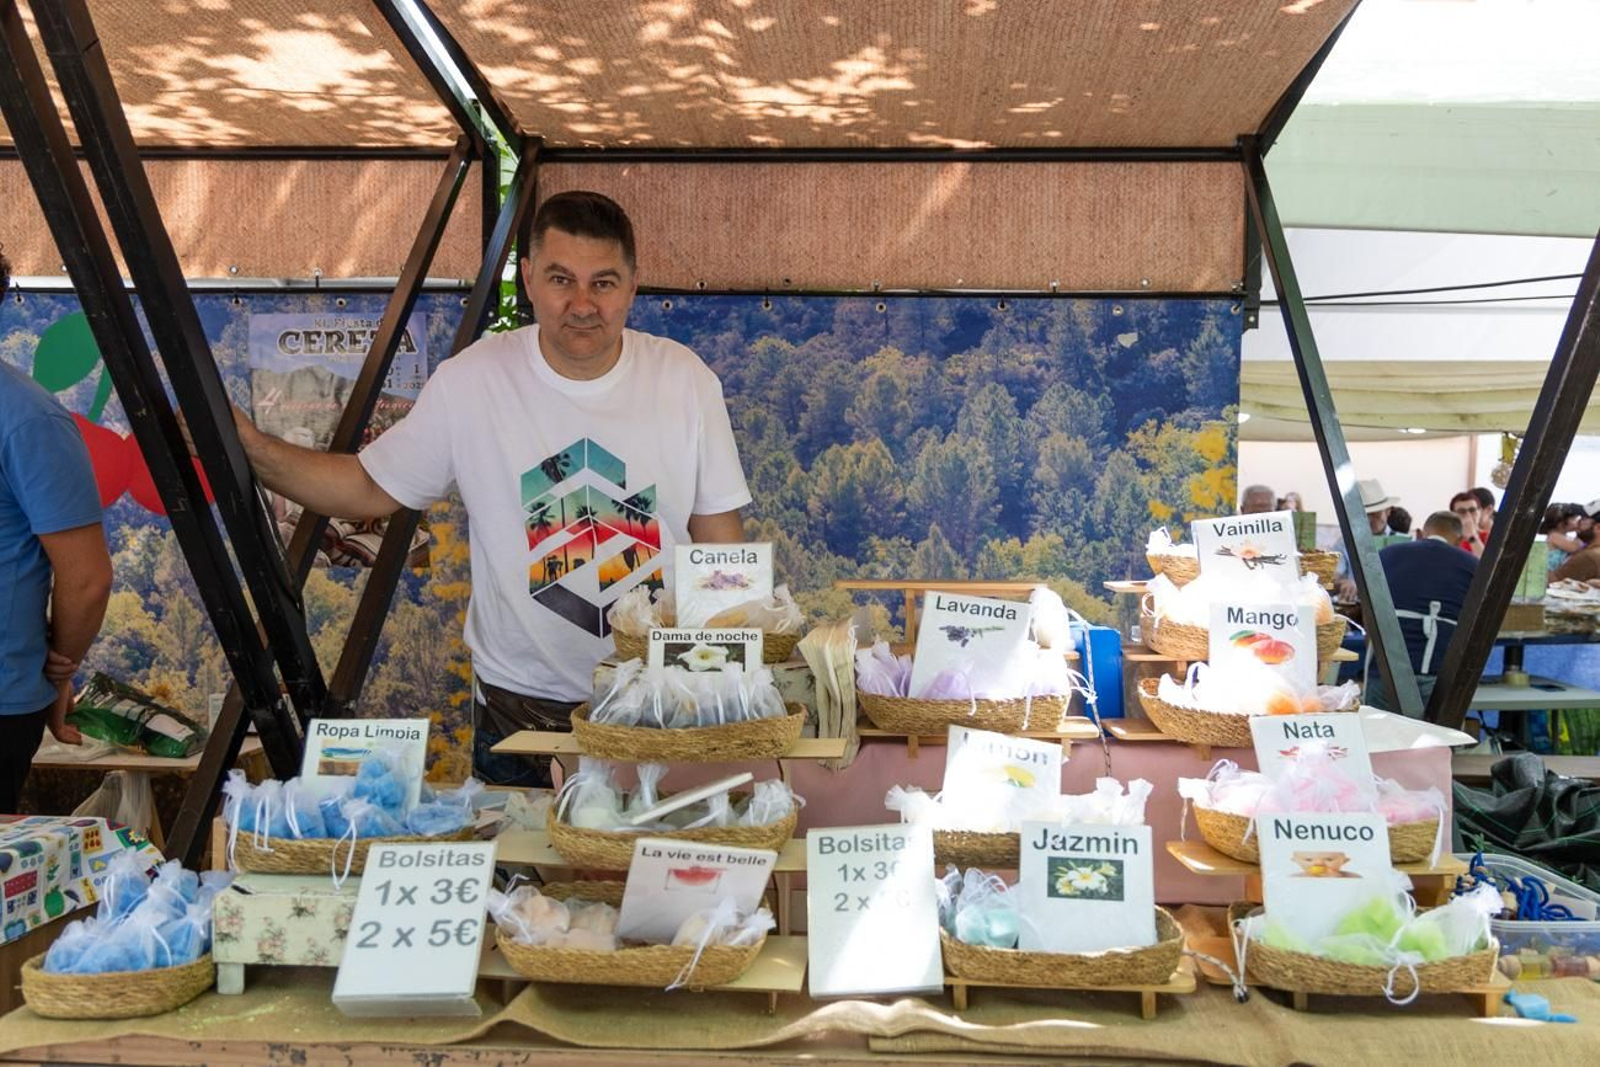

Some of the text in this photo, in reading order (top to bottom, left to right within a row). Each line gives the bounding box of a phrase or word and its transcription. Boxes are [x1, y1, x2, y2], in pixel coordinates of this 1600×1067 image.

[277, 329, 418, 354] CEREA
[1212, 518, 1283, 538] Vainilla
[689, 548, 758, 565] Canela
[935, 595, 1017, 620] Lavanda
[1227, 606, 1299, 631] Mango
[651, 630, 758, 642] Dama de noche
[316, 722, 360, 740] Ropa
[1283, 720, 1335, 740] Nata
[1274, 818, 1375, 841] Nenuco
[1033, 828, 1138, 855] Jazmin
[378, 849, 486, 869] Bolsitas
[640, 845, 768, 867] La vie est belle
[429, 877, 480, 906] 3€
[834, 892, 849, 912] 2
[356, 918, 480, 949] 2 x 5€
